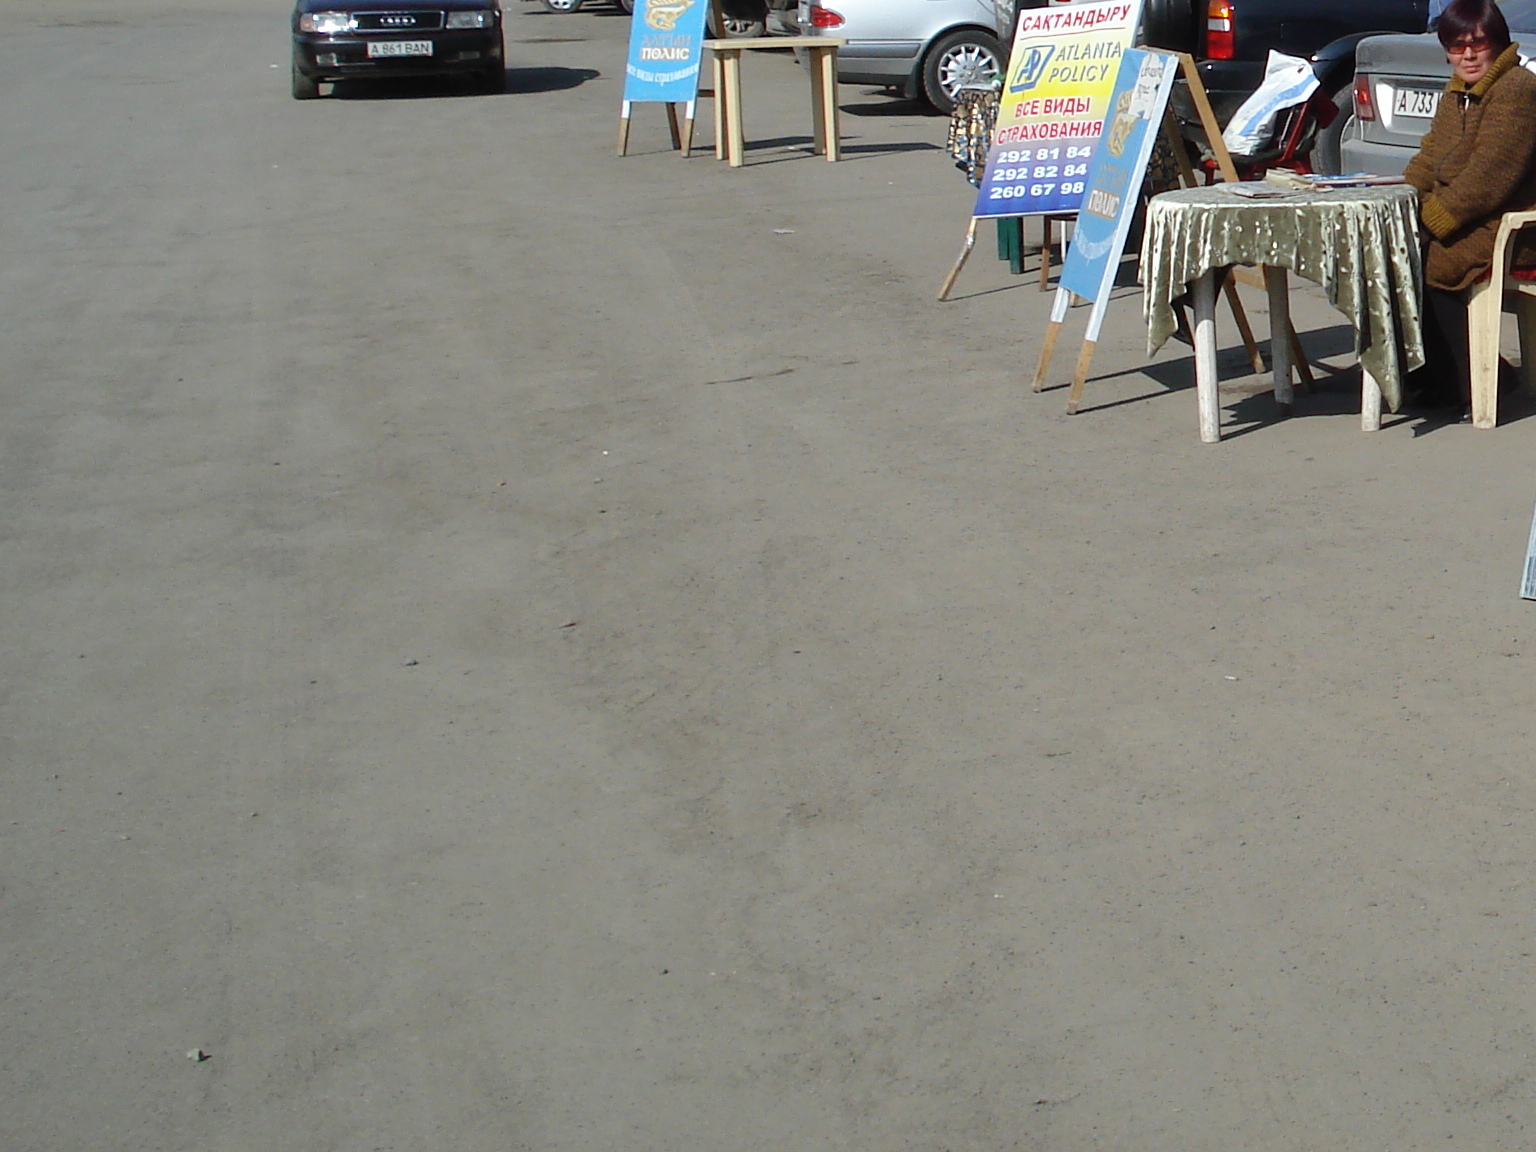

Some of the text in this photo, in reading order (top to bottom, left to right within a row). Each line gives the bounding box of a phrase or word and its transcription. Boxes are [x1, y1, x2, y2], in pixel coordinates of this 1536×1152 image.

[641, 47, 690, 60] ПОЛИС
[1055, 42, 1121, 62] ATLANTA
[1048, 64, 1109, 83] POLICY
[1015, 97, 1091, 118] ВСЕ ВИДЫ
[1398, 91, 1435, 114] A 733
[998, 121, 1103, 145] СТРАХОВАНИЯ
[997, 146, 1091, 164] 292 81 84
[992, 168, 1028, 182] 292
[1033, 166, 1058, 178] 82
[1063, 163, 1087, 177] 84
[989, 182, 1085, 200] 260 67 98
